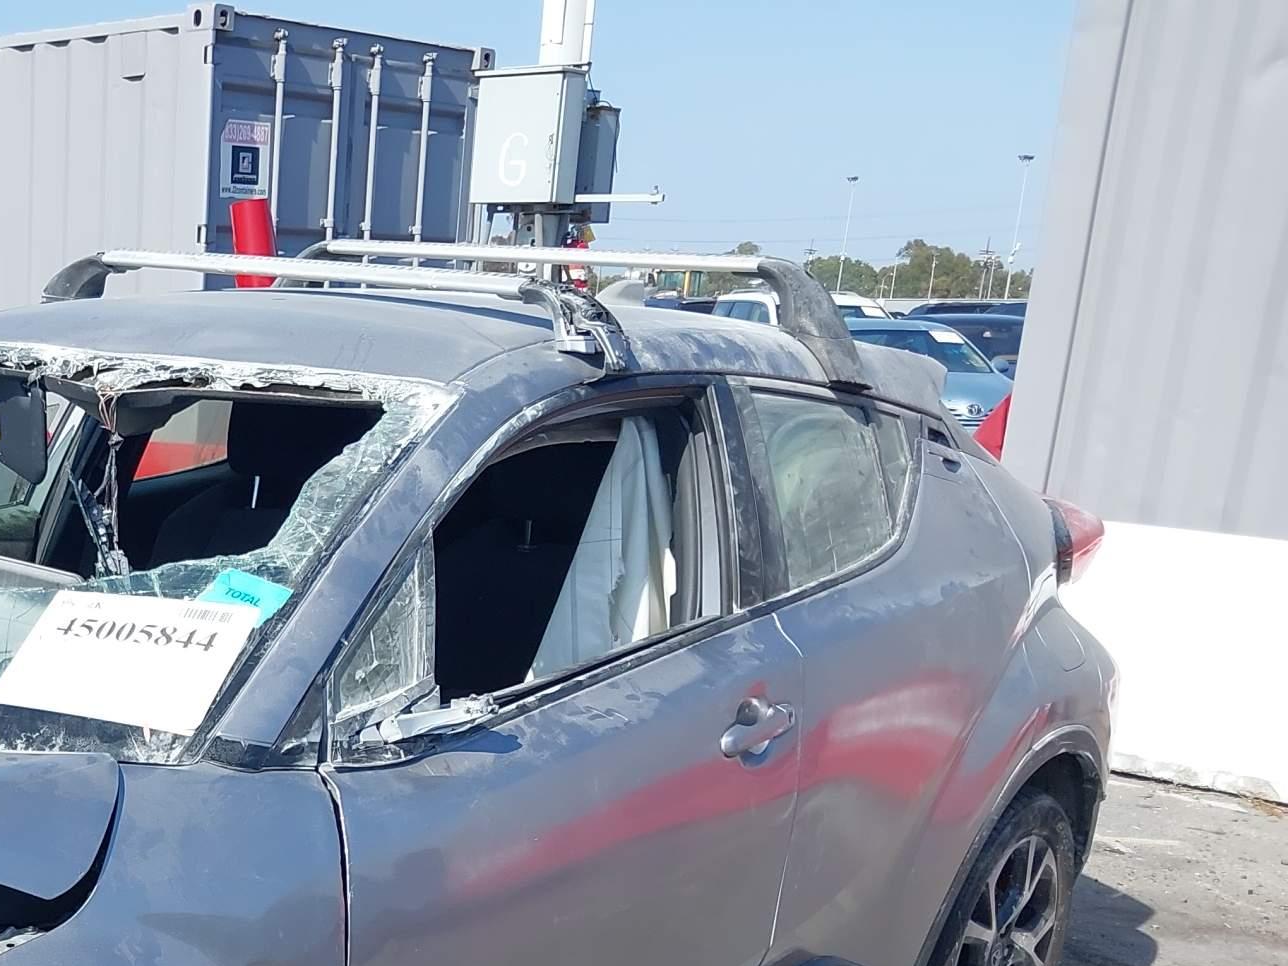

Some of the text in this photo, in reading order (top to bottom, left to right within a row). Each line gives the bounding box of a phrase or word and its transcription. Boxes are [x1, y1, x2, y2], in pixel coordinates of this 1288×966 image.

[498, 131, 528, 187] G
[225, 587, 260, 607] TOTAL
[56, 617, 218, 652] 45005844
